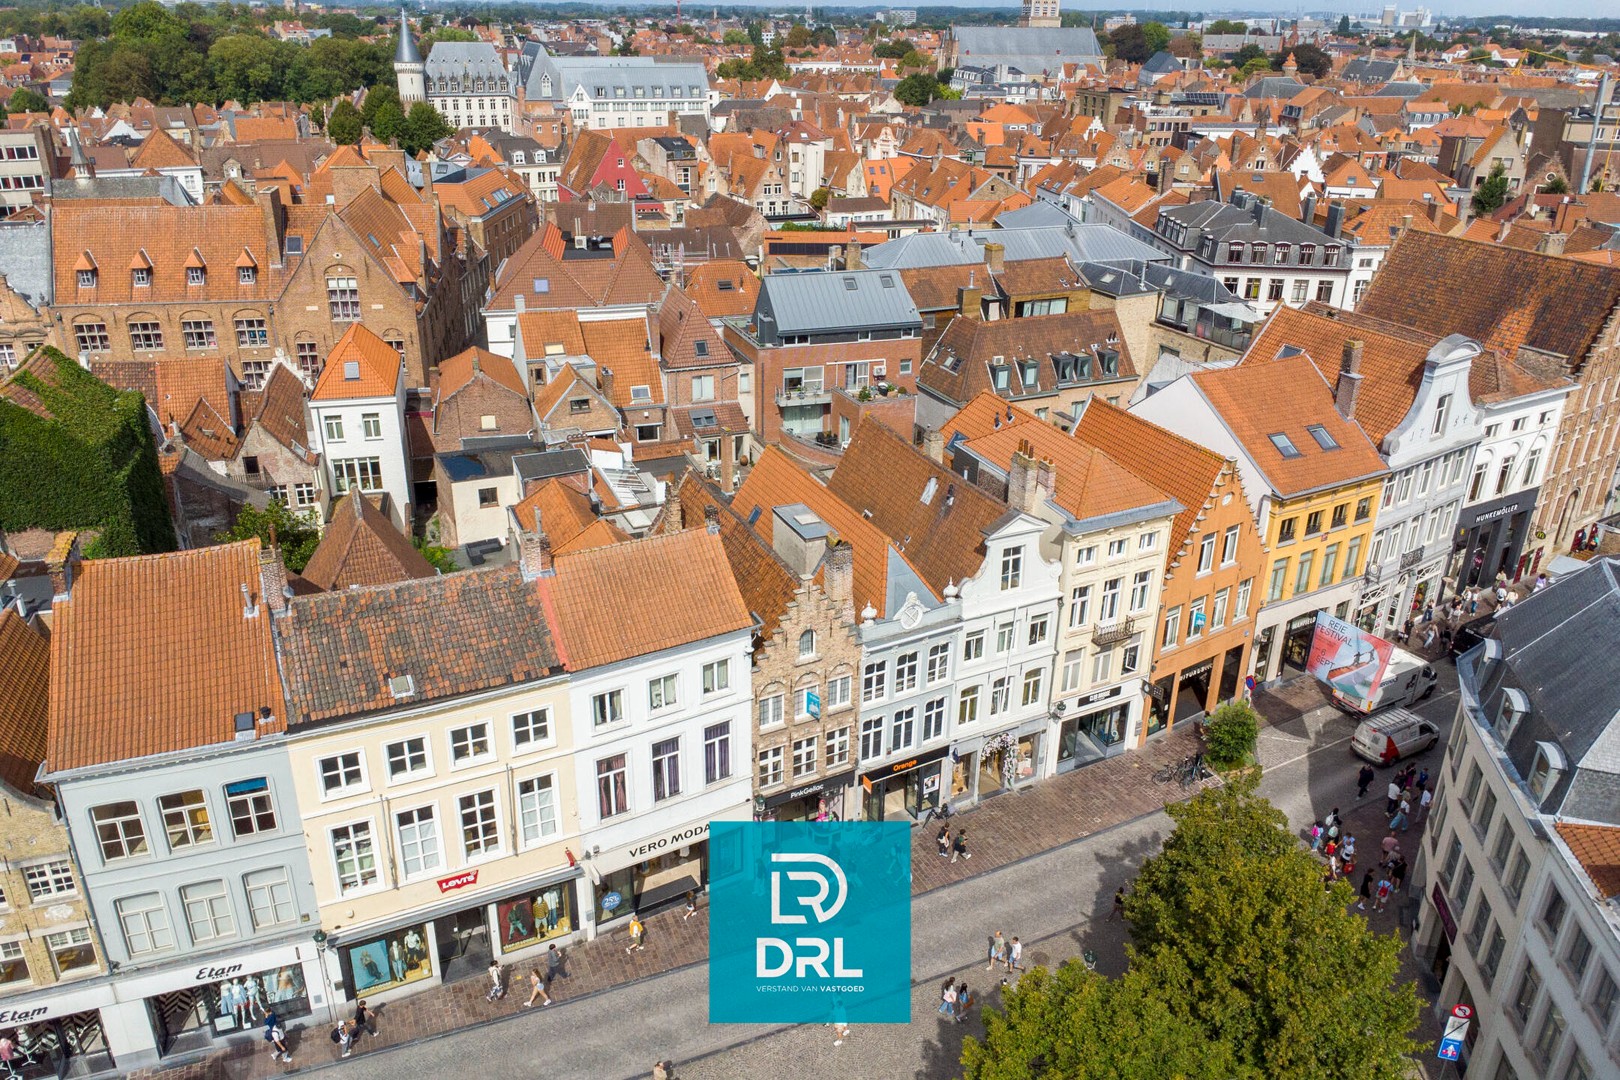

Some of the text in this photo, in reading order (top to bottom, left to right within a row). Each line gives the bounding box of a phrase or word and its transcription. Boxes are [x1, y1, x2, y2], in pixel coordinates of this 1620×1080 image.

[1315, 622, 1353, 648] FESTIVAL
[1328, 619, 1348, 635] REIE
[1315, 655, 1336, 670] SEPT
[893, 759, 918, 771] Orange
[629, 823, 711, 858] VERO MODA
[195, 963, 243, 980] Etam
[0, 1006, 48, 1023] Etam
